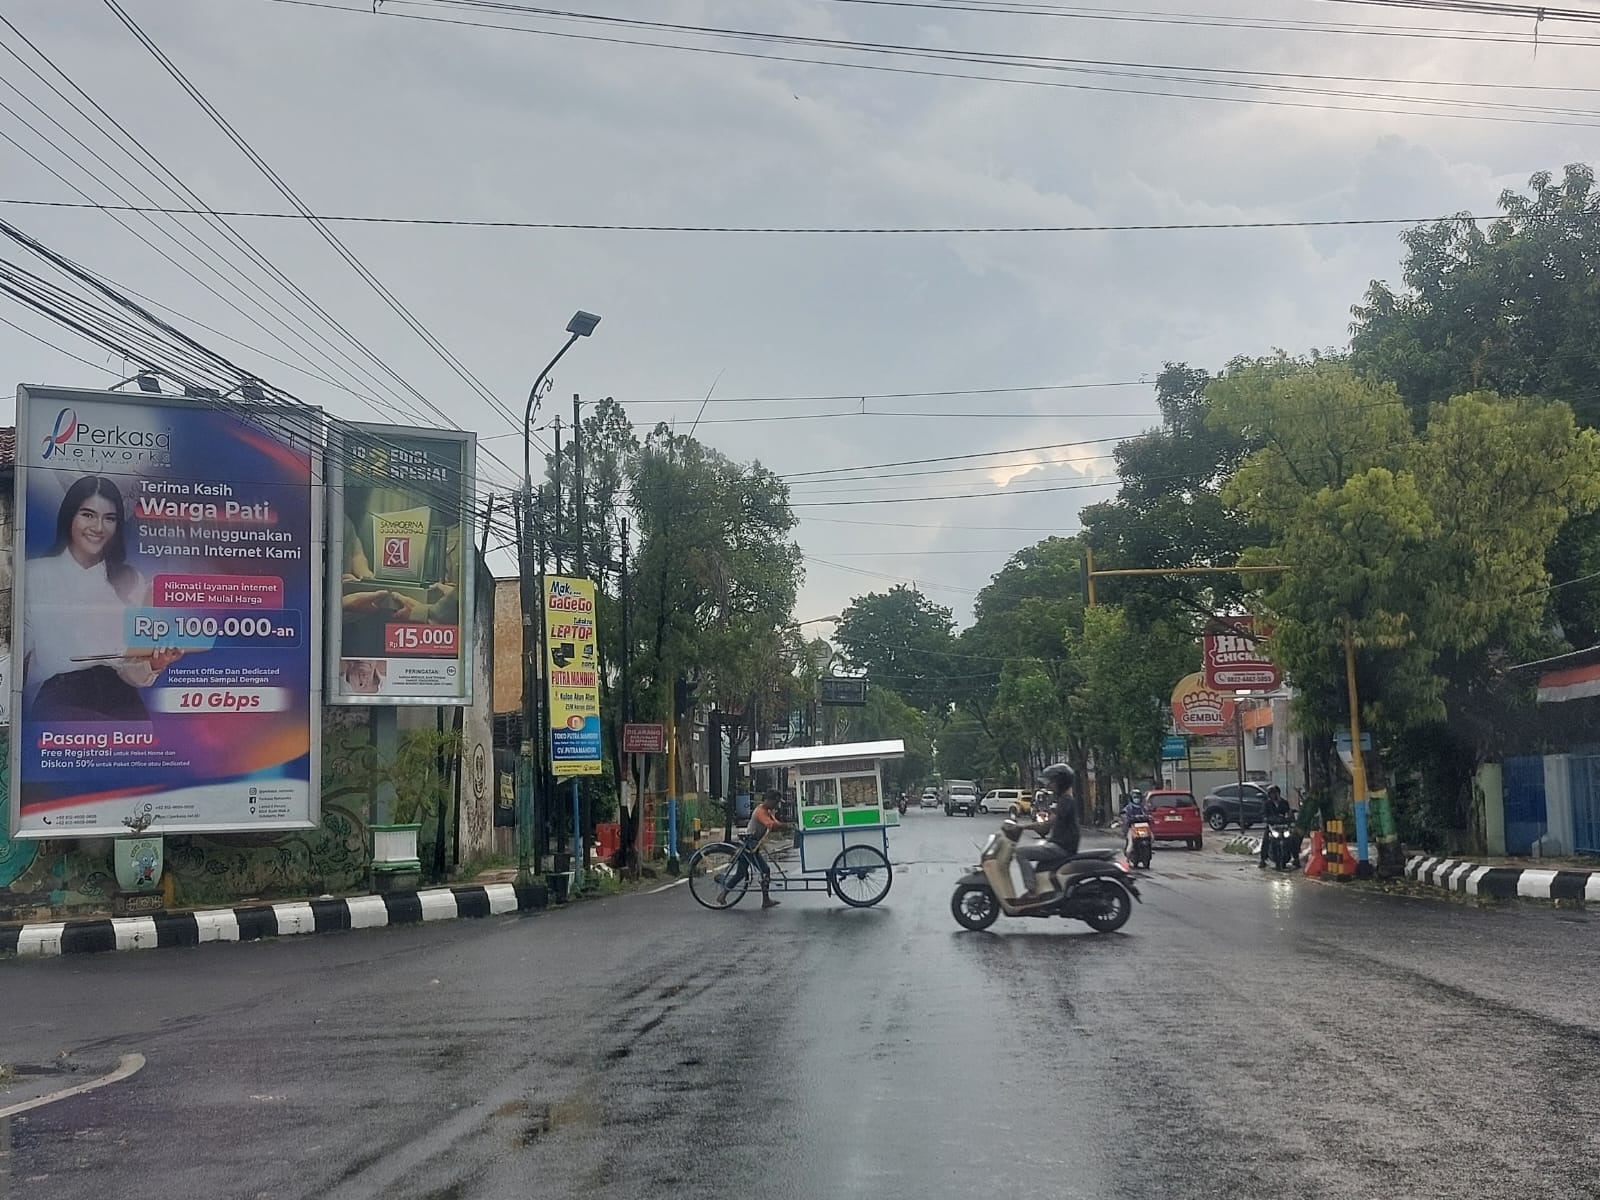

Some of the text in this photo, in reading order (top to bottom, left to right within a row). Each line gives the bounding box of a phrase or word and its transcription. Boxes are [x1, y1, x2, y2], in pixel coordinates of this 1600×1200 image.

[76, 423, 170, 450] Perkasa
[140, 480, 233, 496] Terima Kasih
[140, 497, 270, 521] Warga Pati
[381, 520, 424, 529] SAMPOERNA
[139, 525, 292, 543] Sudah Menggunakan
[139, 543, 302, 559] Layanan Internet Kami
[165, 582, 277, 593] Nikmati layanan internet
[165, 592, 262, 605] HOME Mulai Harga
[549, 595, 593, 612] GaGeGo
[135, 617, 295, 640] Rp 100.000-an
[550, 625, 593, 640] LEPTOP
[168, 668, 280, 676] Internet Office Dan Dedicated
[552, 670, 596, 687] PUTRA MANDIRI
[168, 676, 269, 685] Kecepatan Sampai Dengan
[180, 692, 260, 710] 10 Gbps
[1182, 713, 1225, 722] GEMBUL
[41, 732, 153, 748] Pasang Baru
[41, 749, 62, 757] Free
[64, 748, 112, 758] Registrasi
[41, 760, 73, 768] Diskon
[75, 759, 95, 768] 50%
